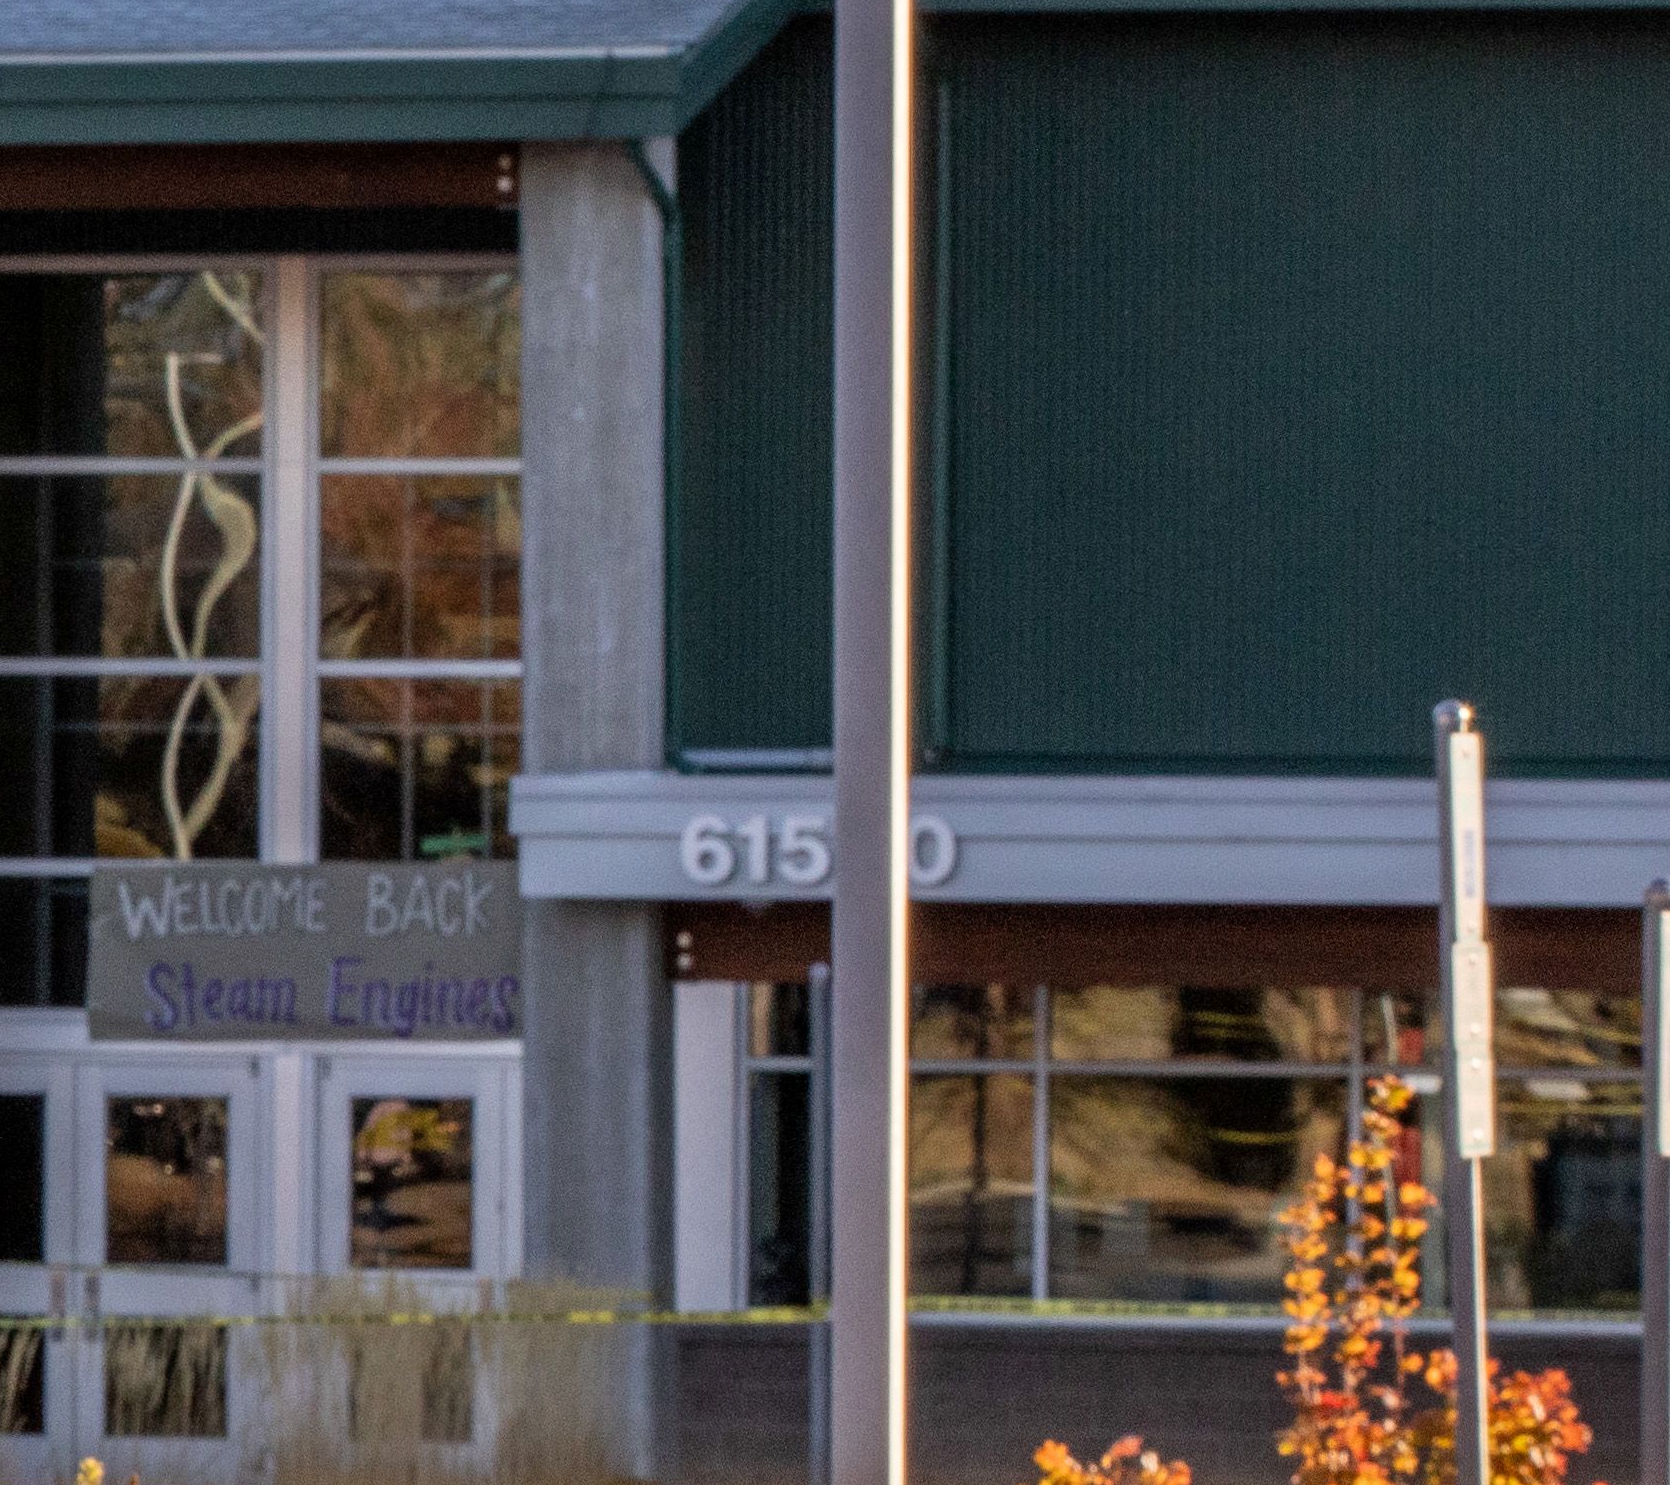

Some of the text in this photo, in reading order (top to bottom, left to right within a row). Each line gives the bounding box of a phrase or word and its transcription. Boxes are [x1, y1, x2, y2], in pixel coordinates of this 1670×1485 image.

[680, 815, 956, 886] 6150
[118, 870, 492, 939] WELCOME BACK
[144, 955, 520, 1038] Steam Engines
